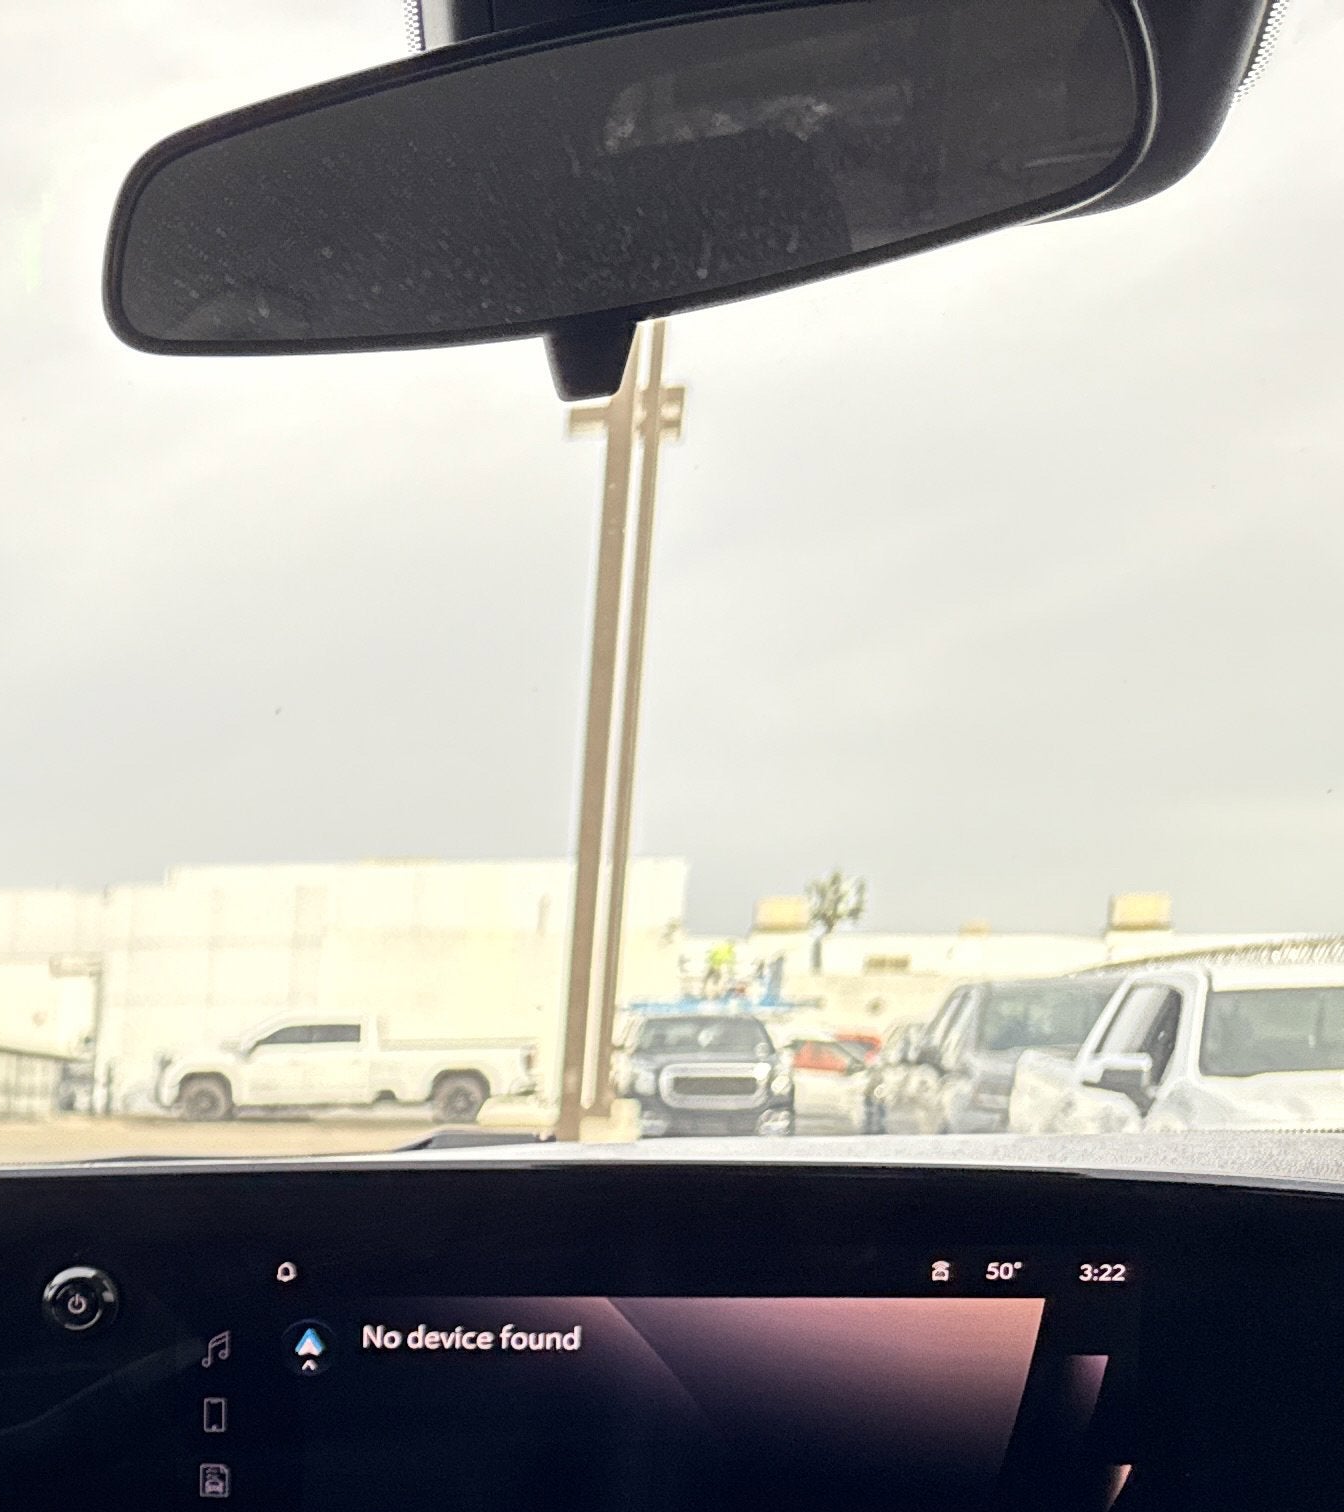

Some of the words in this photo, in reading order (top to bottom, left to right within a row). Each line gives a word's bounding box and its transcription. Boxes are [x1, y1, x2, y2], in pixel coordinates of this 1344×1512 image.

[985, 1261, 1023, 1281] 50°
[1078, 1263, 1127, 1282] 3:22
[362, 1324, 402, 1350] No
[406, 1324, 495, 1350] device
[499, 1323, 582, 1350] found
